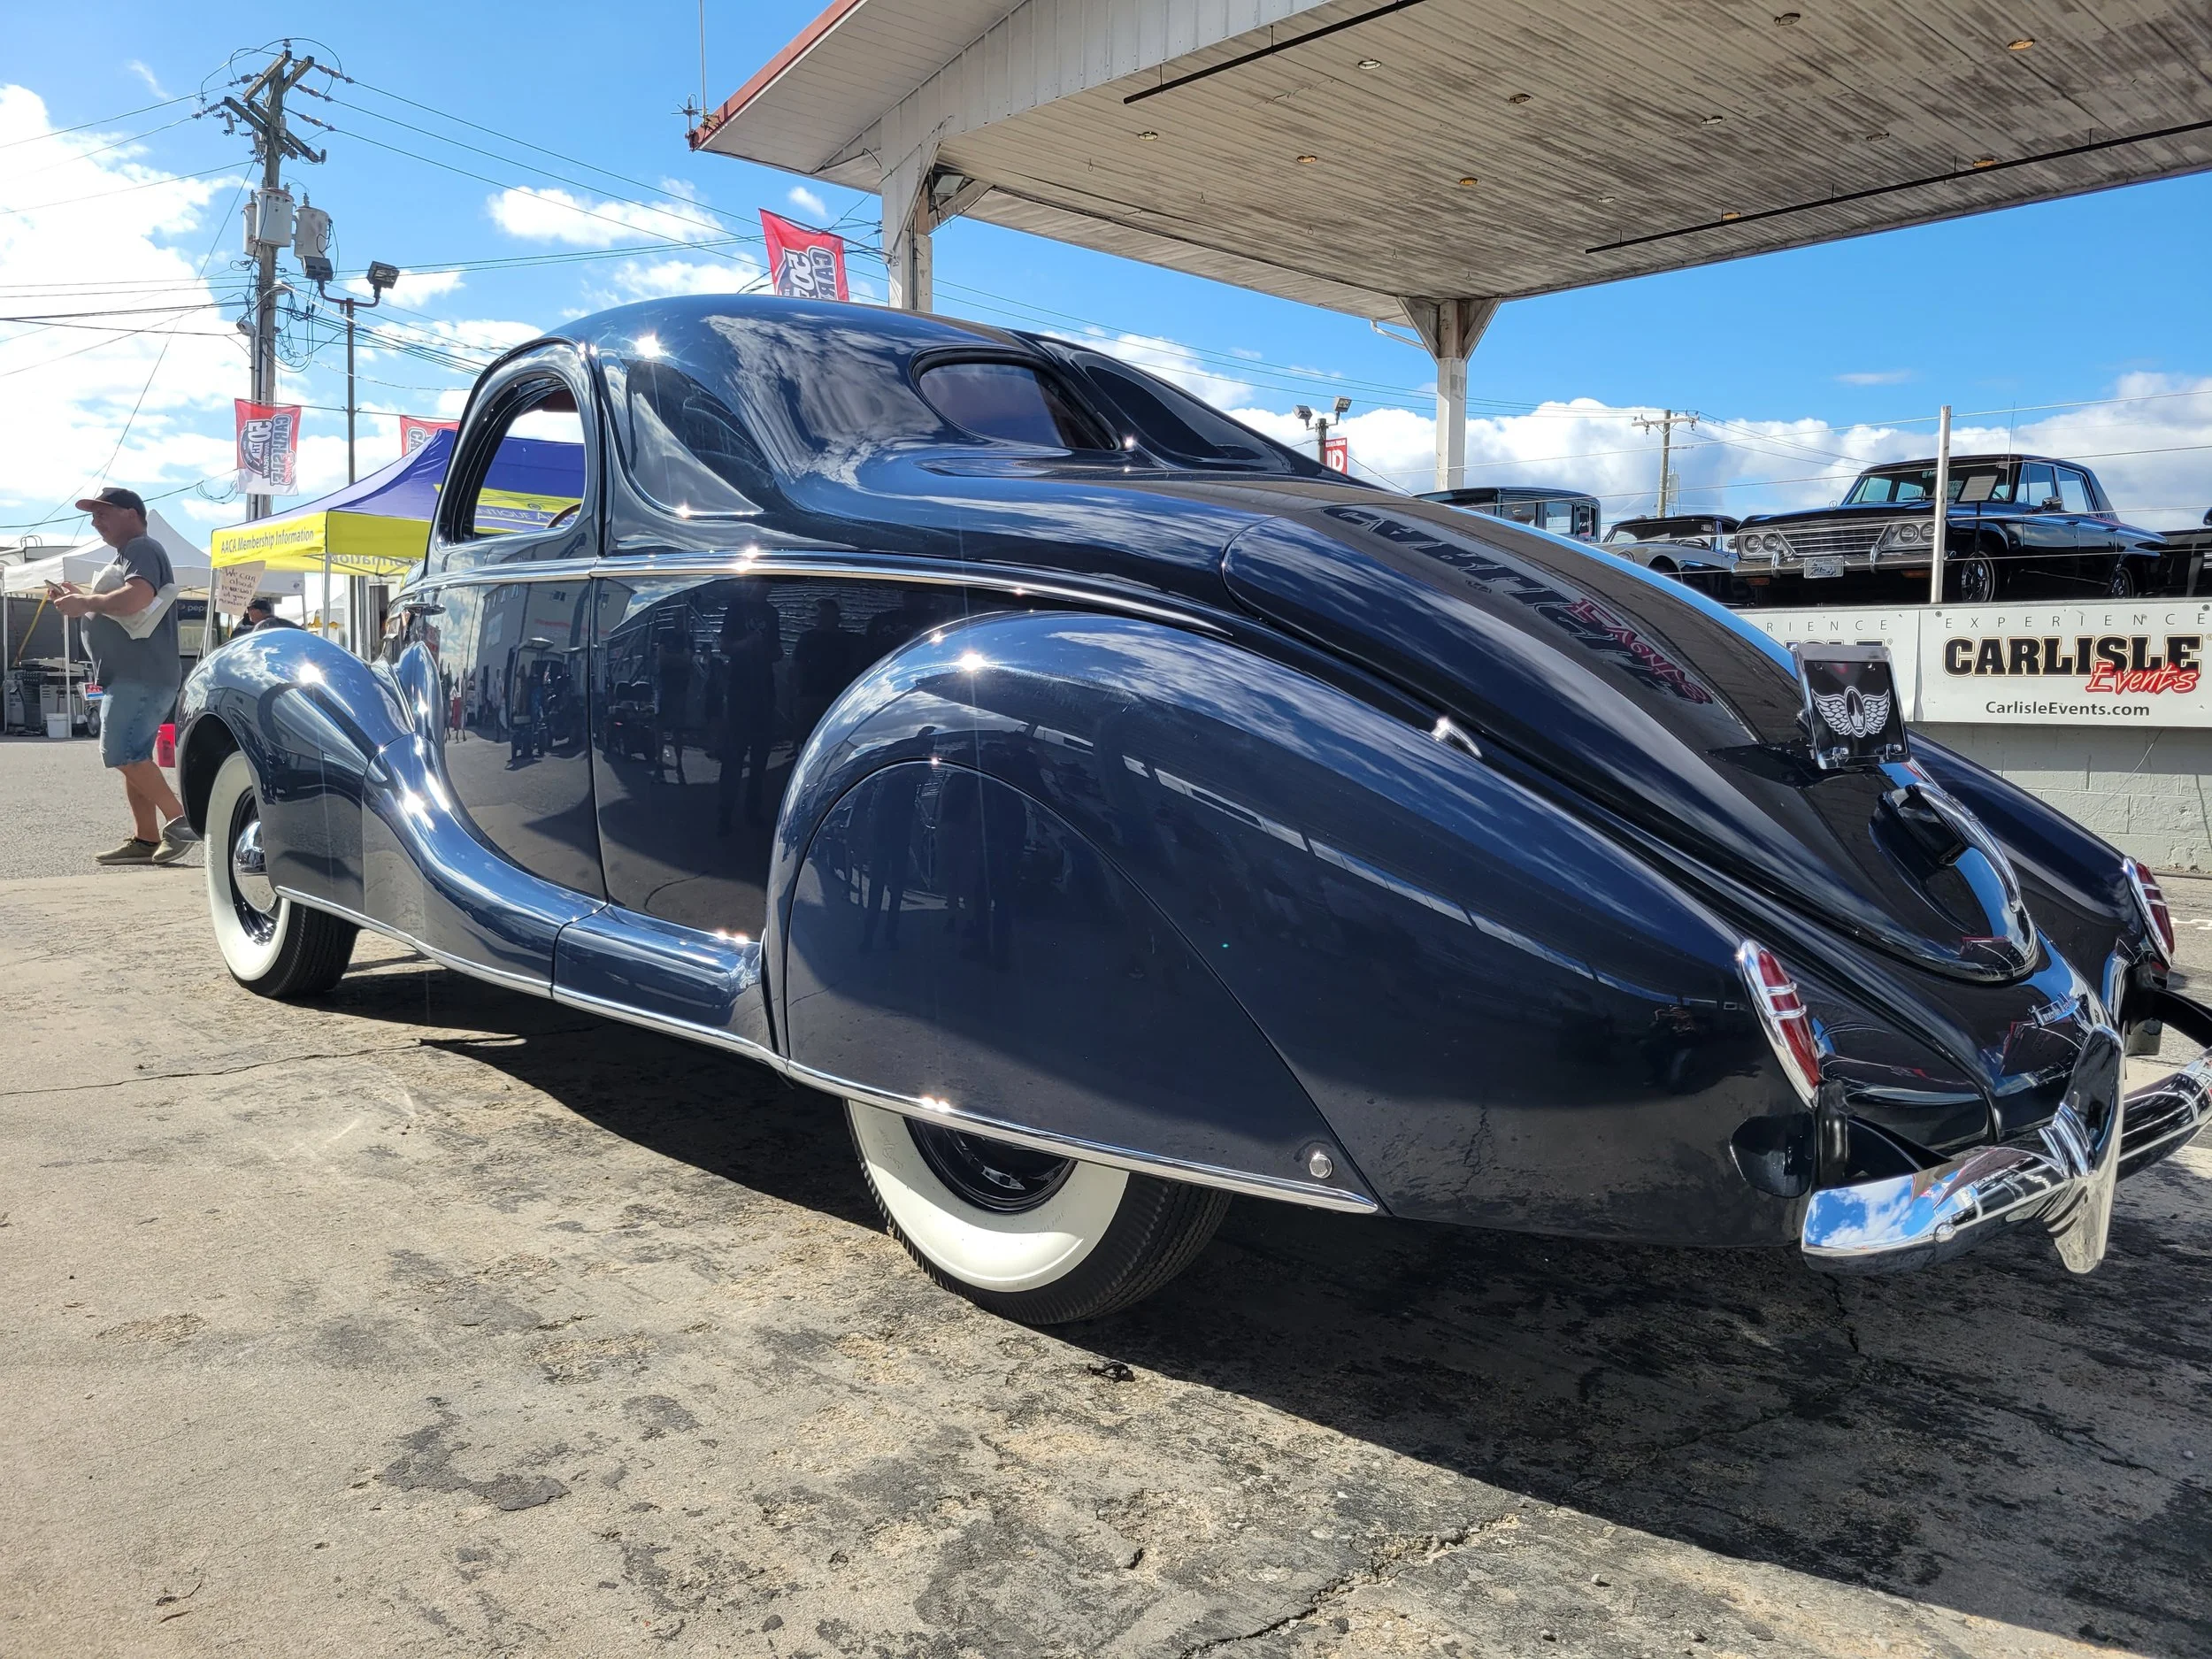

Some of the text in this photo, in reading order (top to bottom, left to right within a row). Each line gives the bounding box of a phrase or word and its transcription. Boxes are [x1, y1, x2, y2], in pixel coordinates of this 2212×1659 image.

[220, 526, 313, 554] AACA Membership Information
[225, 567, 237, 577] We
[1946, 612, 2206, 629] EXPERIENCE
[1944, 635, 2203, 676] CARLISLE
[2086, 661, 2200, 694] Events
[1985, 701, 2150, 717] CarlisleEvents.com
